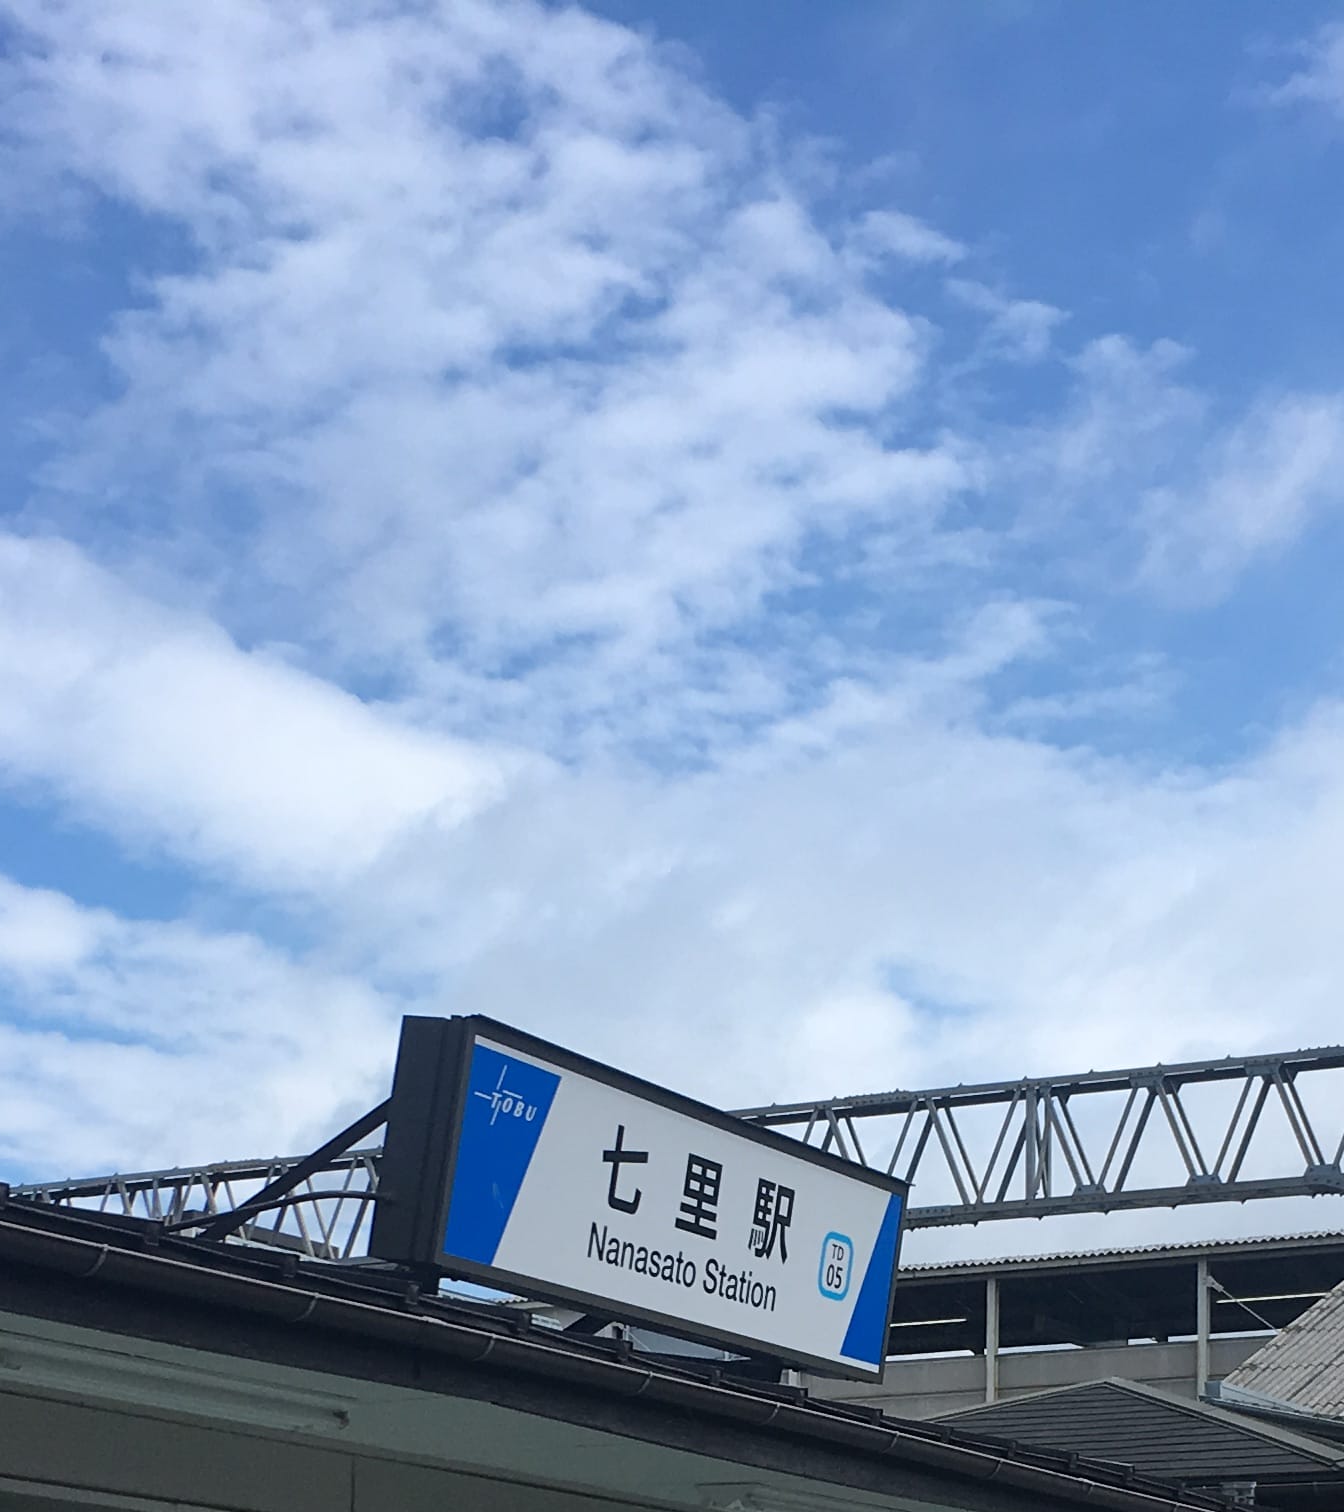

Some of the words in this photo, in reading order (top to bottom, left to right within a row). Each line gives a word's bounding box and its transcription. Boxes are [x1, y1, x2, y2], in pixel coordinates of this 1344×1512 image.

[490, 1091, 537, 1122] TOBU
[602, 1123, 796, 1266] 七里駅
[587, 1221, 697, 1288] Nanasato
[702, 1257, 777, 1312] Station
[832, 1244, 844, 1261] TD
[826, 1264, 843, 1289] 05
